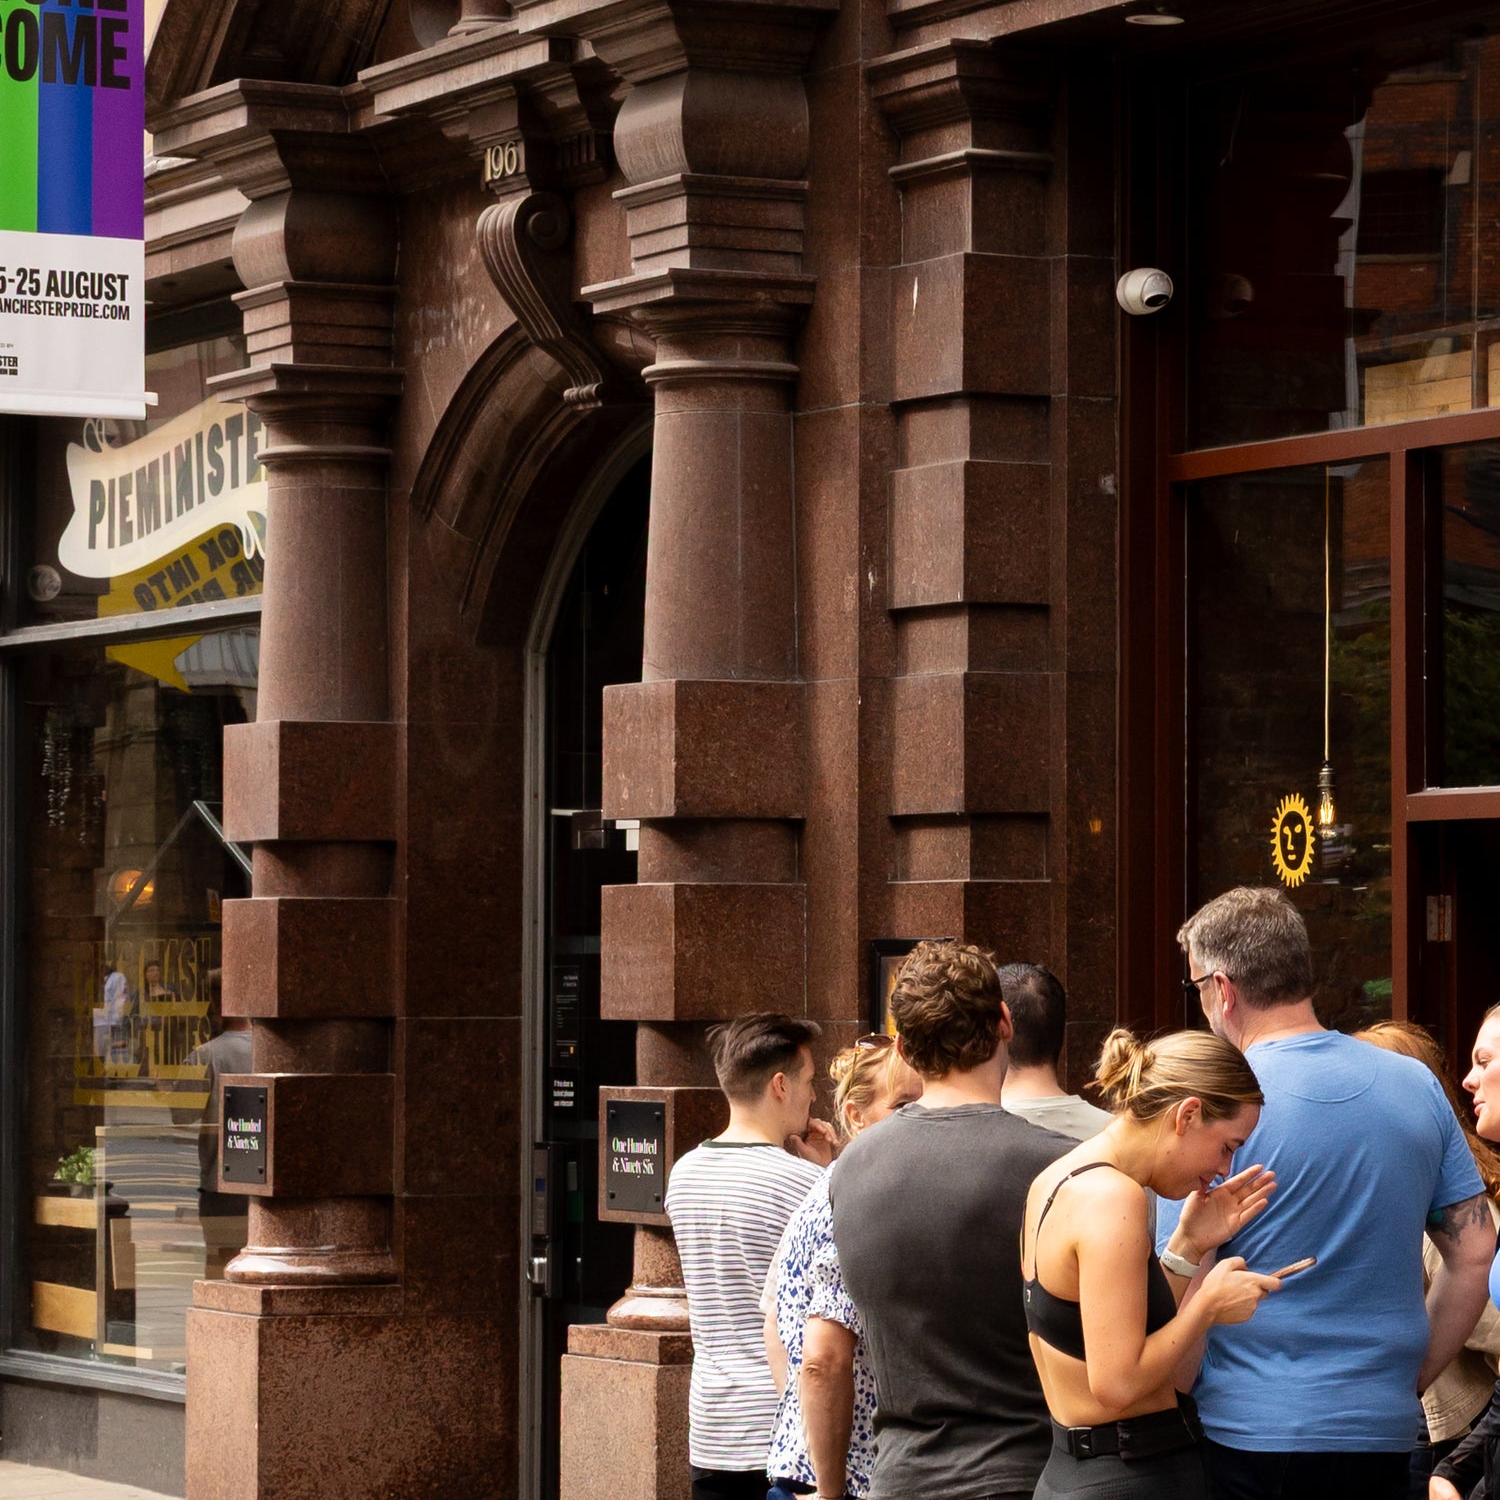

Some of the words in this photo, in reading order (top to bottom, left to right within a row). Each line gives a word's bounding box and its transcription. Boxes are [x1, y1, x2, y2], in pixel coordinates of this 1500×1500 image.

[0, 8, 131, 90] OME
[485, 141, 518, 183] 196
[45, 269, 129, 302] AUGUST
[88, 409, 269, 550] PIEMINISTE
[612, 1137, 626, 1153] One
[627, 1138, 657, 1155] Hundred
[612, 1157, 619, 1173] &
[620, 1157, 643, 1178] Ninety
[643, 1158, 654, 1175] Six
